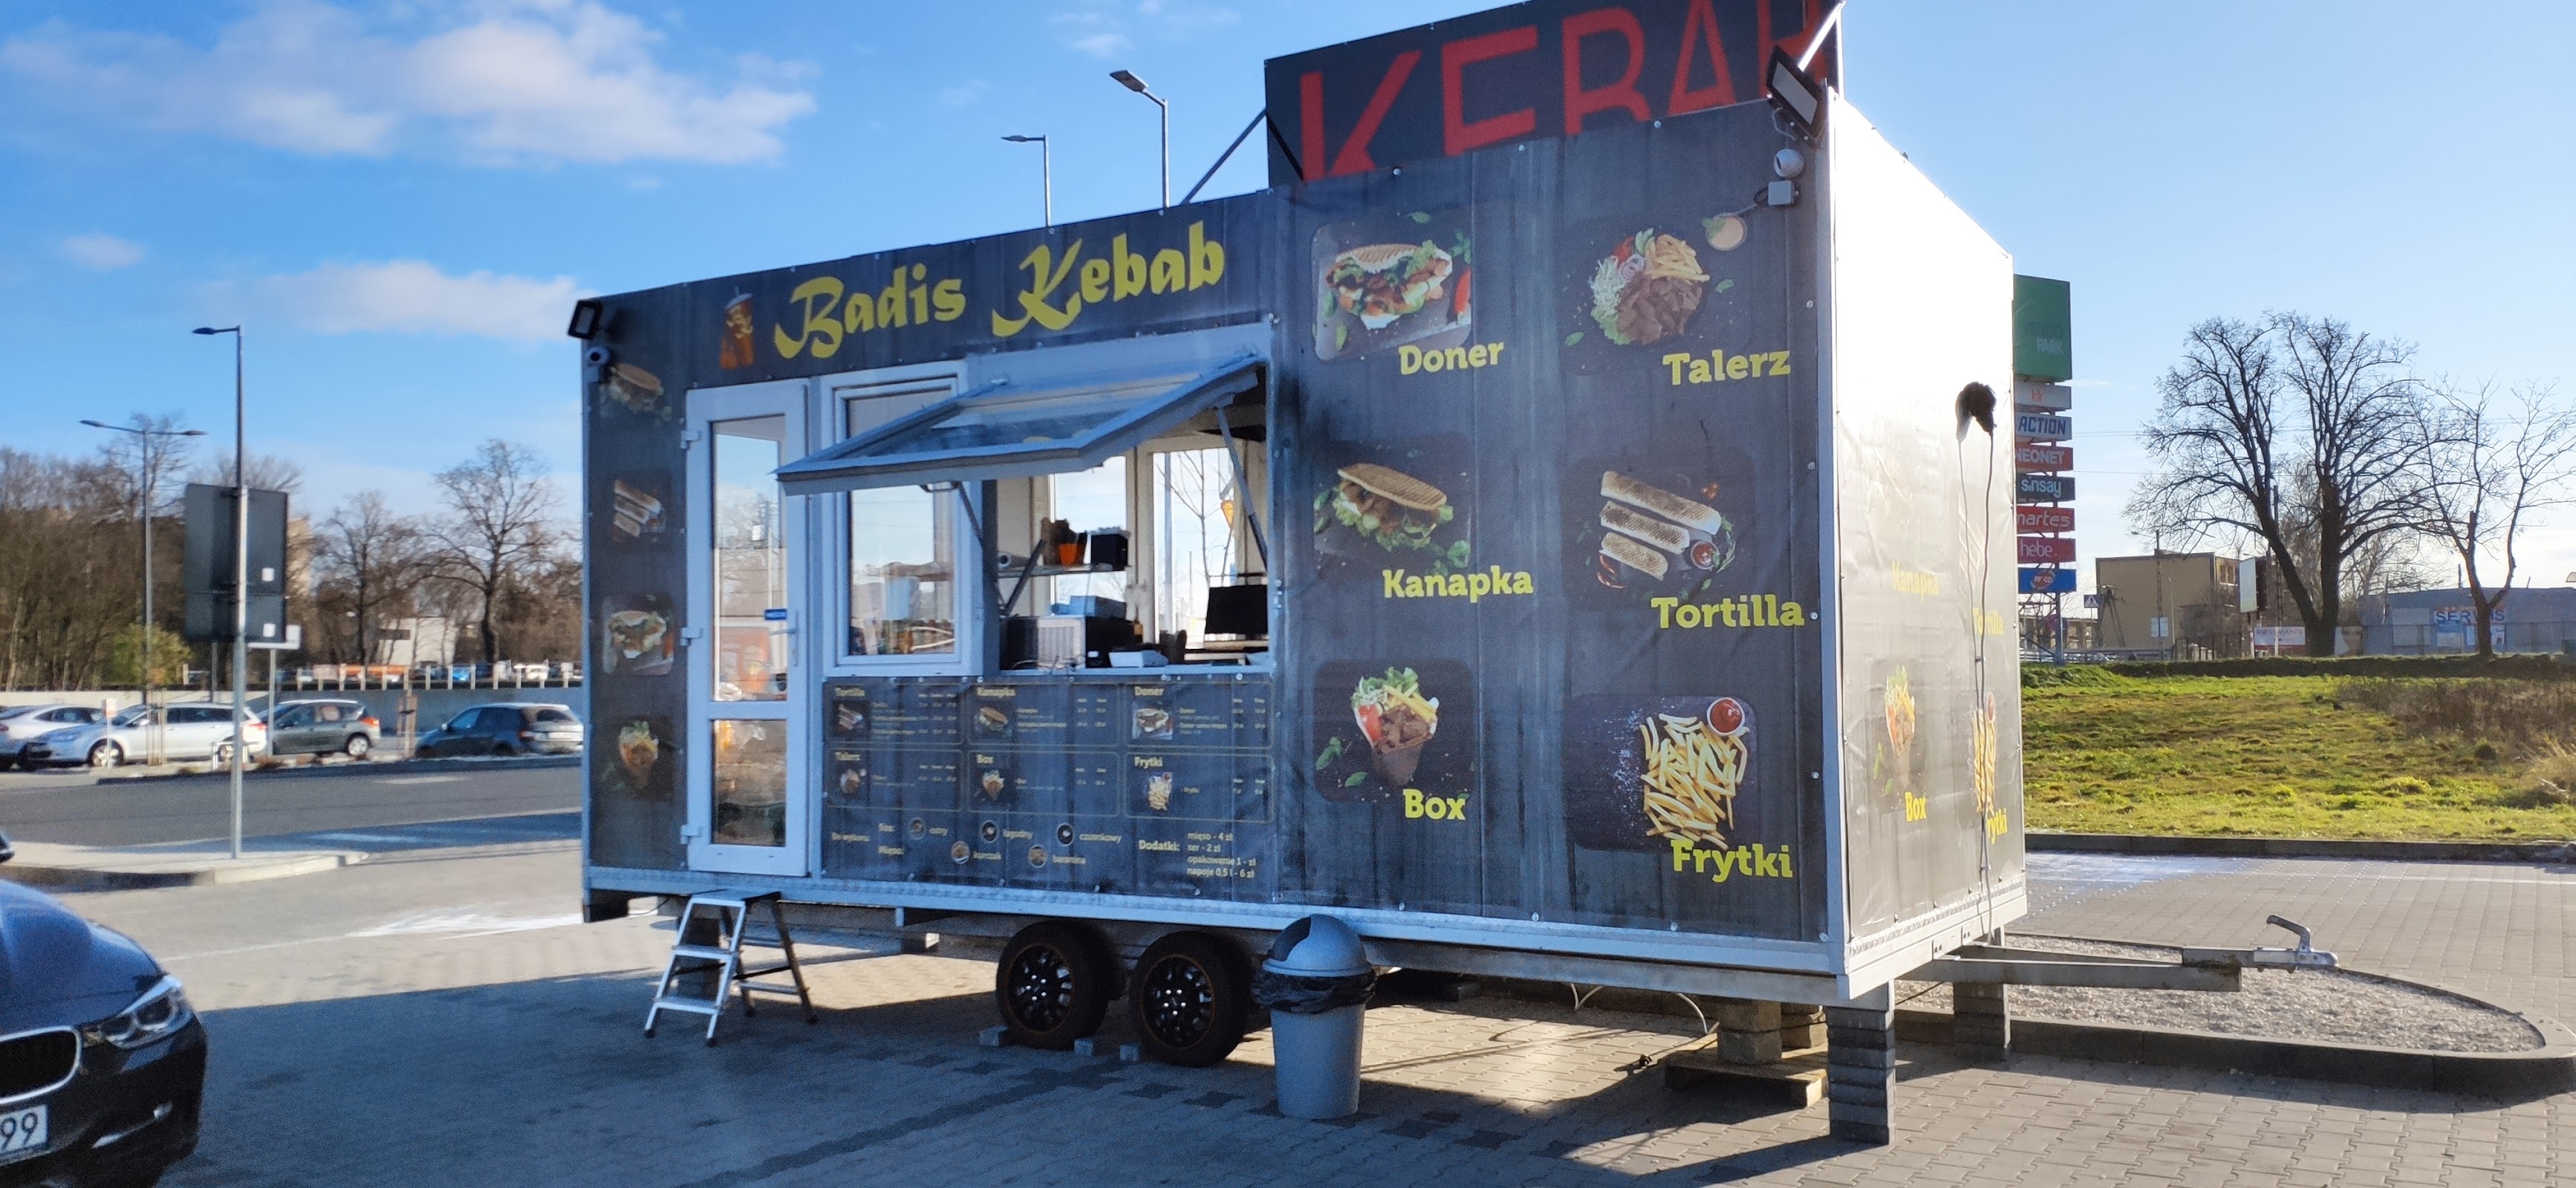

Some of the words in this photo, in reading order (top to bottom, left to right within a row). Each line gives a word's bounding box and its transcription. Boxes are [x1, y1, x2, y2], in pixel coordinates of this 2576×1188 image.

[774, 264, 966, 359] Badis
[992, 221, 1225, 337] Kebab
[2037, 338, 2064, 355] PARK
[1397, 342, 1504, 375] Doner
[1662, 349, 1791, 385] Talerz
[2018, 416, 2066, 435] ACTION
[2015, 448, 2065, 466] NEONET
[2021, 476, 2061, 498] sinsay
[1382, 565, 1534, 603] Kanapka
[1891, 561, 1940, 602] Kanapka
[2034, 575, 2052, 584] PECO
[1650, 594, 1805, 629] Tortilla
[1134, 686, 1165, 696] Doner
[1133, 757, 1164, 769] Frytki
[1402, 789, 1466, 820] Box
[1905, 792, 1927, 823] Box
[1218, 832, 1224, 841] 4
[1986, 807, 2008, 844] rytki
[1138, 840, 1180, 852] Dodatki:
[1206, 843, 1212, 852] 2
[1670, 839, 1793, 883] Frytki
[1239, 869, 1246, 878] 6
